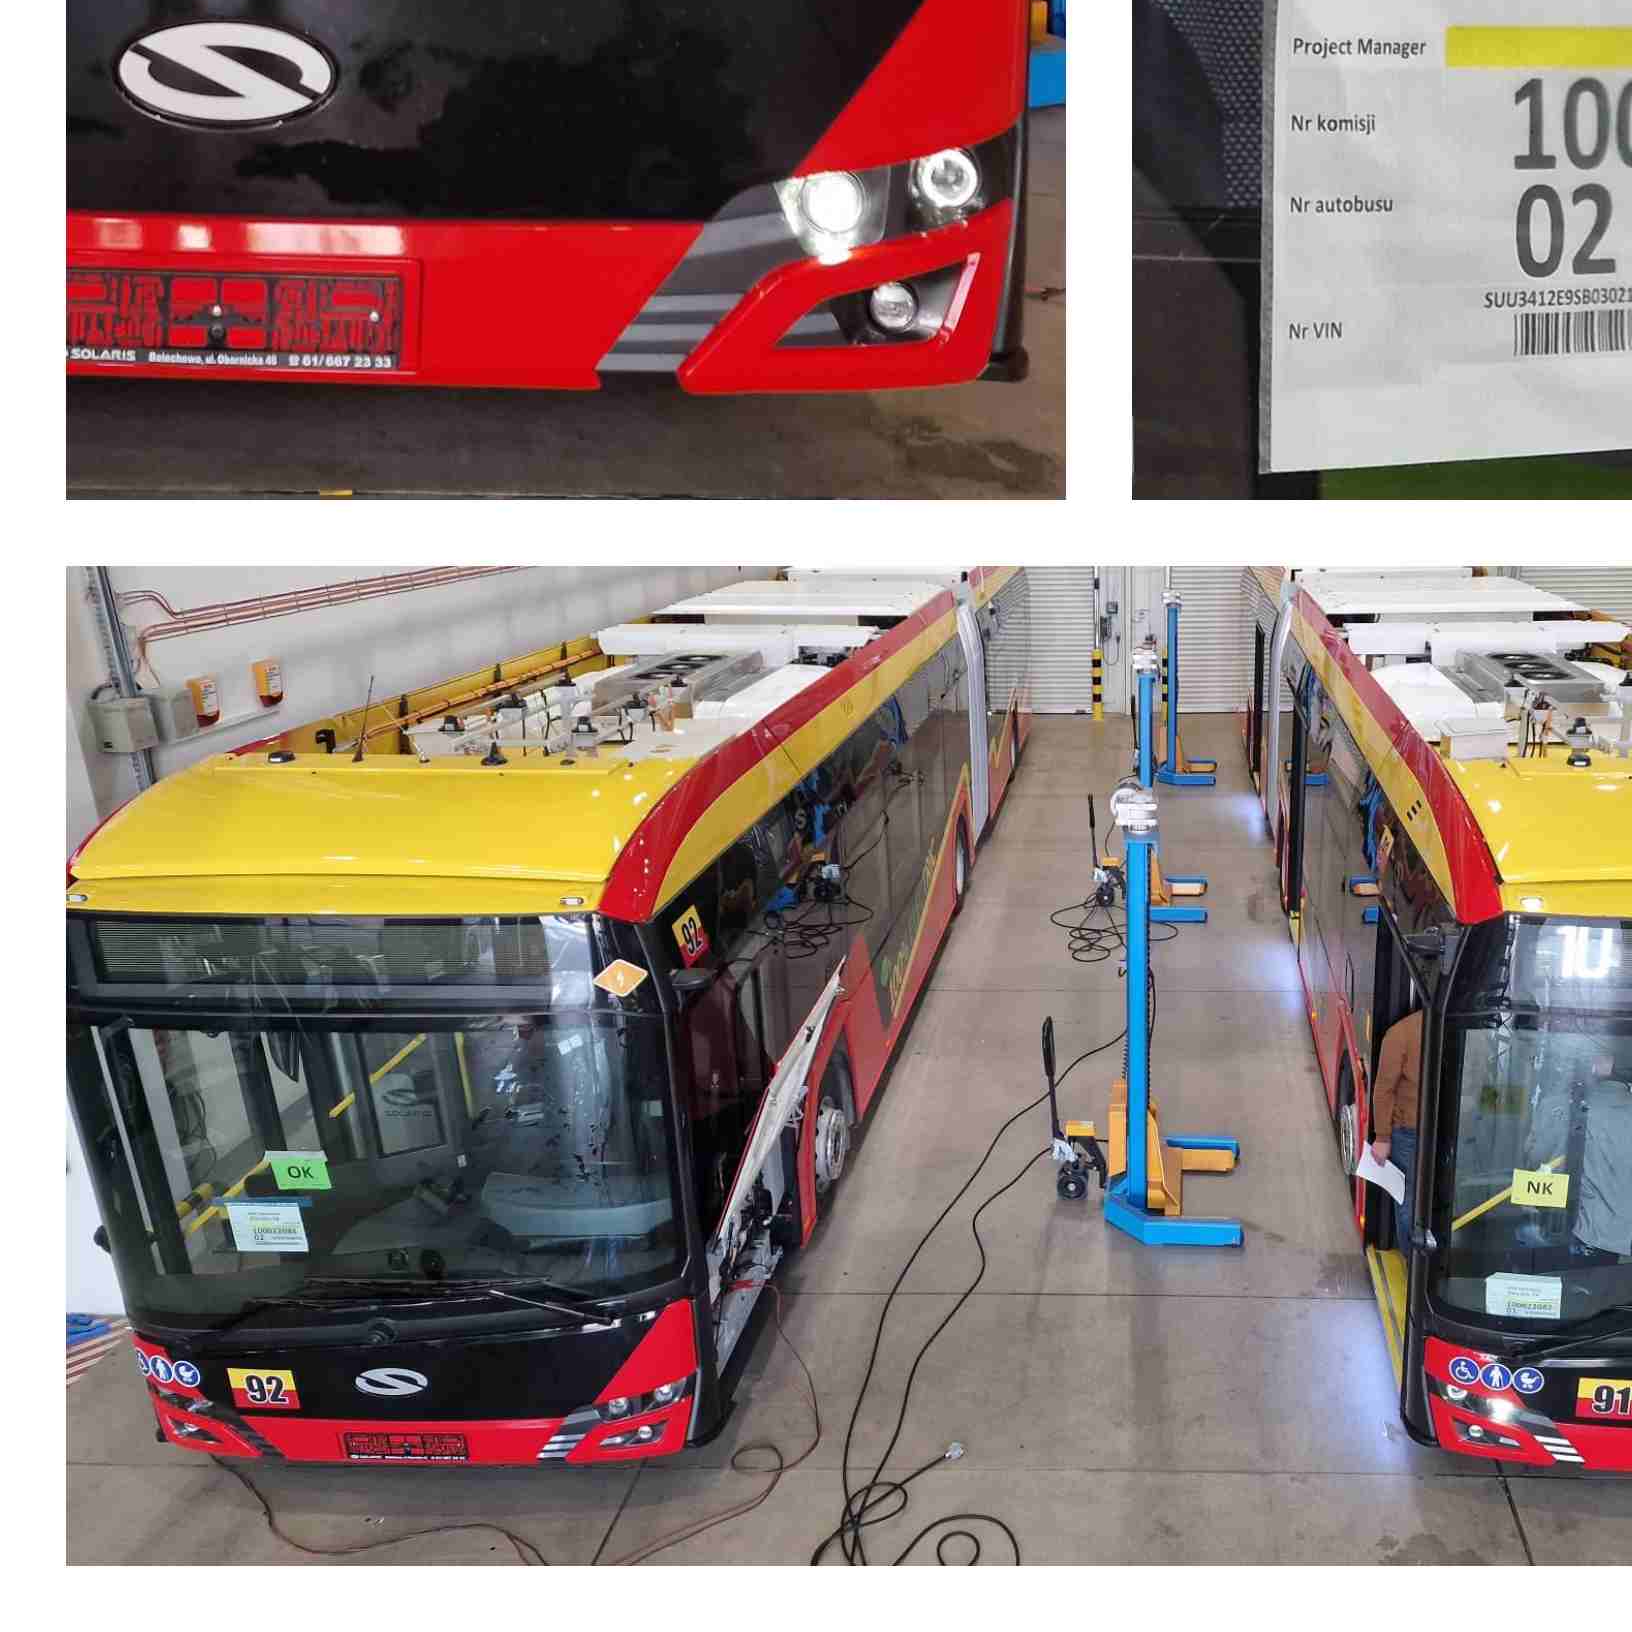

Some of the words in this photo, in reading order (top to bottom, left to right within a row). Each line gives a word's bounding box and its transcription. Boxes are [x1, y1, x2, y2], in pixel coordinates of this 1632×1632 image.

[1293, 37, 1353, 59] Project
[1357, 37, 1427, 59] Manager
[1291, 114, 1312, 131] Nr
[1317, 113, 1376, 135] komisji
[1290, 197, 1311, 213] Nr
[1315, 195, 1393, 213] autobusu
[1515, 182, 1617, 279] 02
[1289, 322, 1309, 339] Nr
[1313, 322, 1343, 339] VIN
[70, 348, 136, 362] SOLARIS
[287, 1165, 315, 1180] OK
[1526, 1180, 1554, 1196] NK
[245, 1374, 289, 1404] 92
[1591, 1384, 1632, 1416] 91
